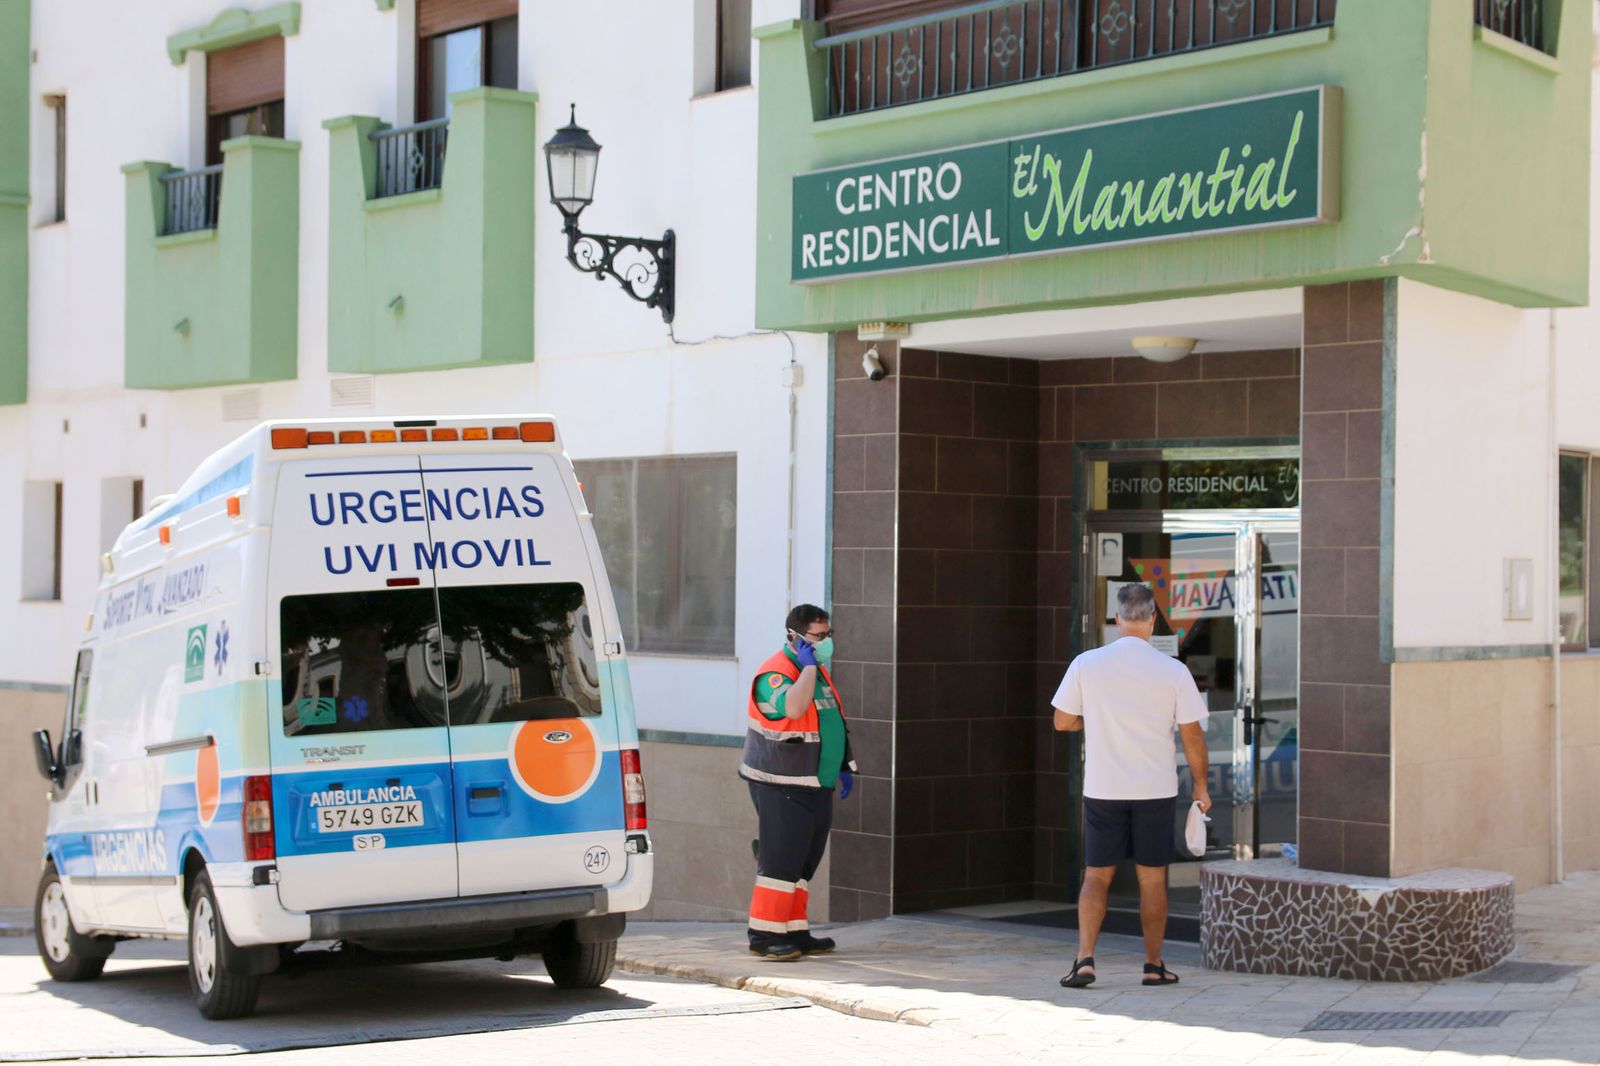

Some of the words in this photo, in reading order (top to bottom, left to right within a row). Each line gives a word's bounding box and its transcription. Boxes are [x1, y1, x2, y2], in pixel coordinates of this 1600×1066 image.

[835, 161, 963, 215] CENTRO
[1012, 144, 1041, 198] El
[1024, 110, 1304, 242] Manantial
[802, 208, 1000, 269] RESIDENCIAL
[1106, 477, 1162, 494] CENTRO
[1167, 476, 1268, 493] RESIDENCIAL
[309, 485, 545, 526] URGENCIAS
[324, 543, 398, 575] UVI
[413, 538, 552, 570] MOVIL
[300, 744, 366, 758] TRANSIT
[310, 785, 416, 807] AMBULANCIA
[322, 806, 374, 829] 5749
[381, 804, 419, 825] GZK
[92, 830, 167, 872] URGENCIAS
[586, 852, 607, 868] 247
